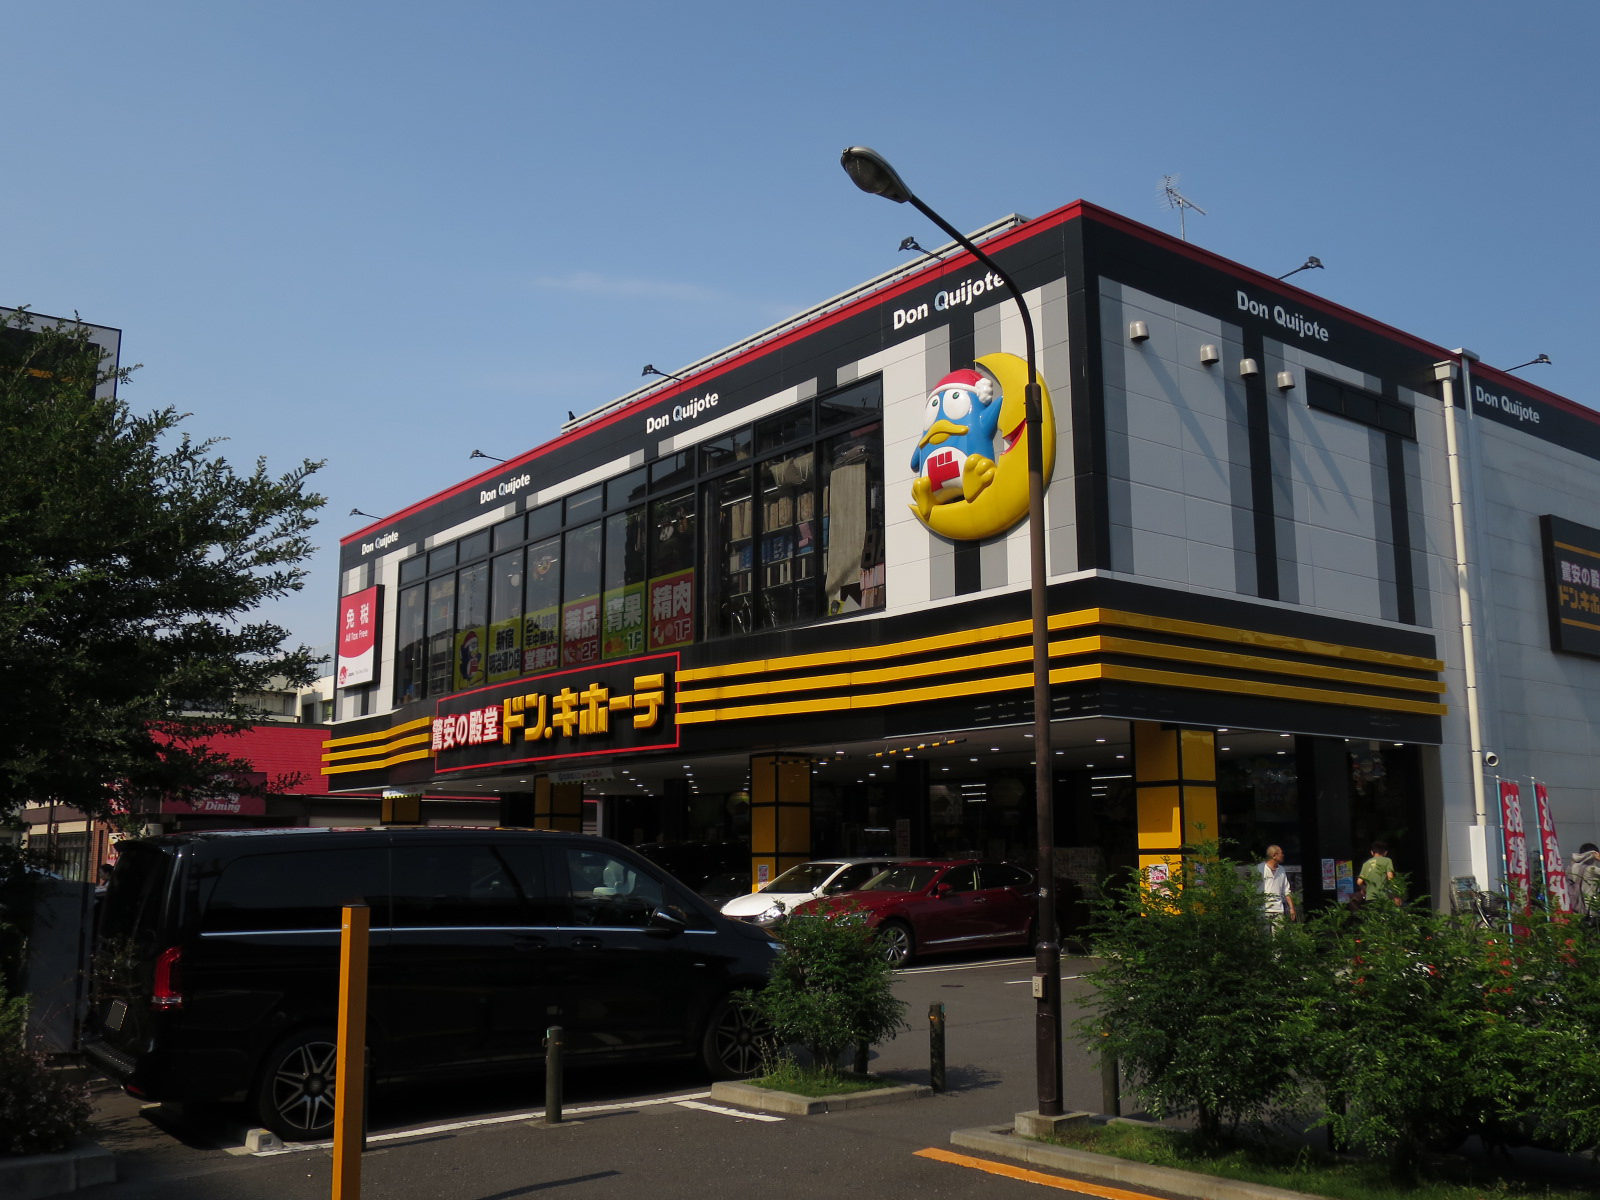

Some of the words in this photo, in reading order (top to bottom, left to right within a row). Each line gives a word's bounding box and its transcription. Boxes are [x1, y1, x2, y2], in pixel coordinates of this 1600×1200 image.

[894, 303, 928, 330] Don
[934, 271, 1004, 311] Quijote
[1237, 290, 1268, 319] Don
[1274, 305, 1329, 341] Quijote
[646, 414, 670, 434] Don
[673, 393, 719, 421] Quijote
[1475, 385, 1498, 408] Don
[1501, 395, 1540, 424] Quijote
[480, 489, 497, 504] Don
[498, 473, 531, 495] Quijote
[361, 543, 374, 555] Don
[374, 531, 399, 548] Quijote
[607, 592, 642, 634] 青果
[653, 580, 692, 621] 精肉
[346, 603, 369, 629] 免税
[565, 604, 598, 642] 薬品
[673, 617, 691, 641] 1F
[359, 630, 368, 639] Free
[496, 627, 515, 652] 新宿
[627, 629, 643, 651] 1F
[525, 645, 558, 671] 営業中
[581, 640, 598, 661] 2F
[431, 706, 499, 751] 驚安の殿堂
[204, 801, 241, 813] Dining
